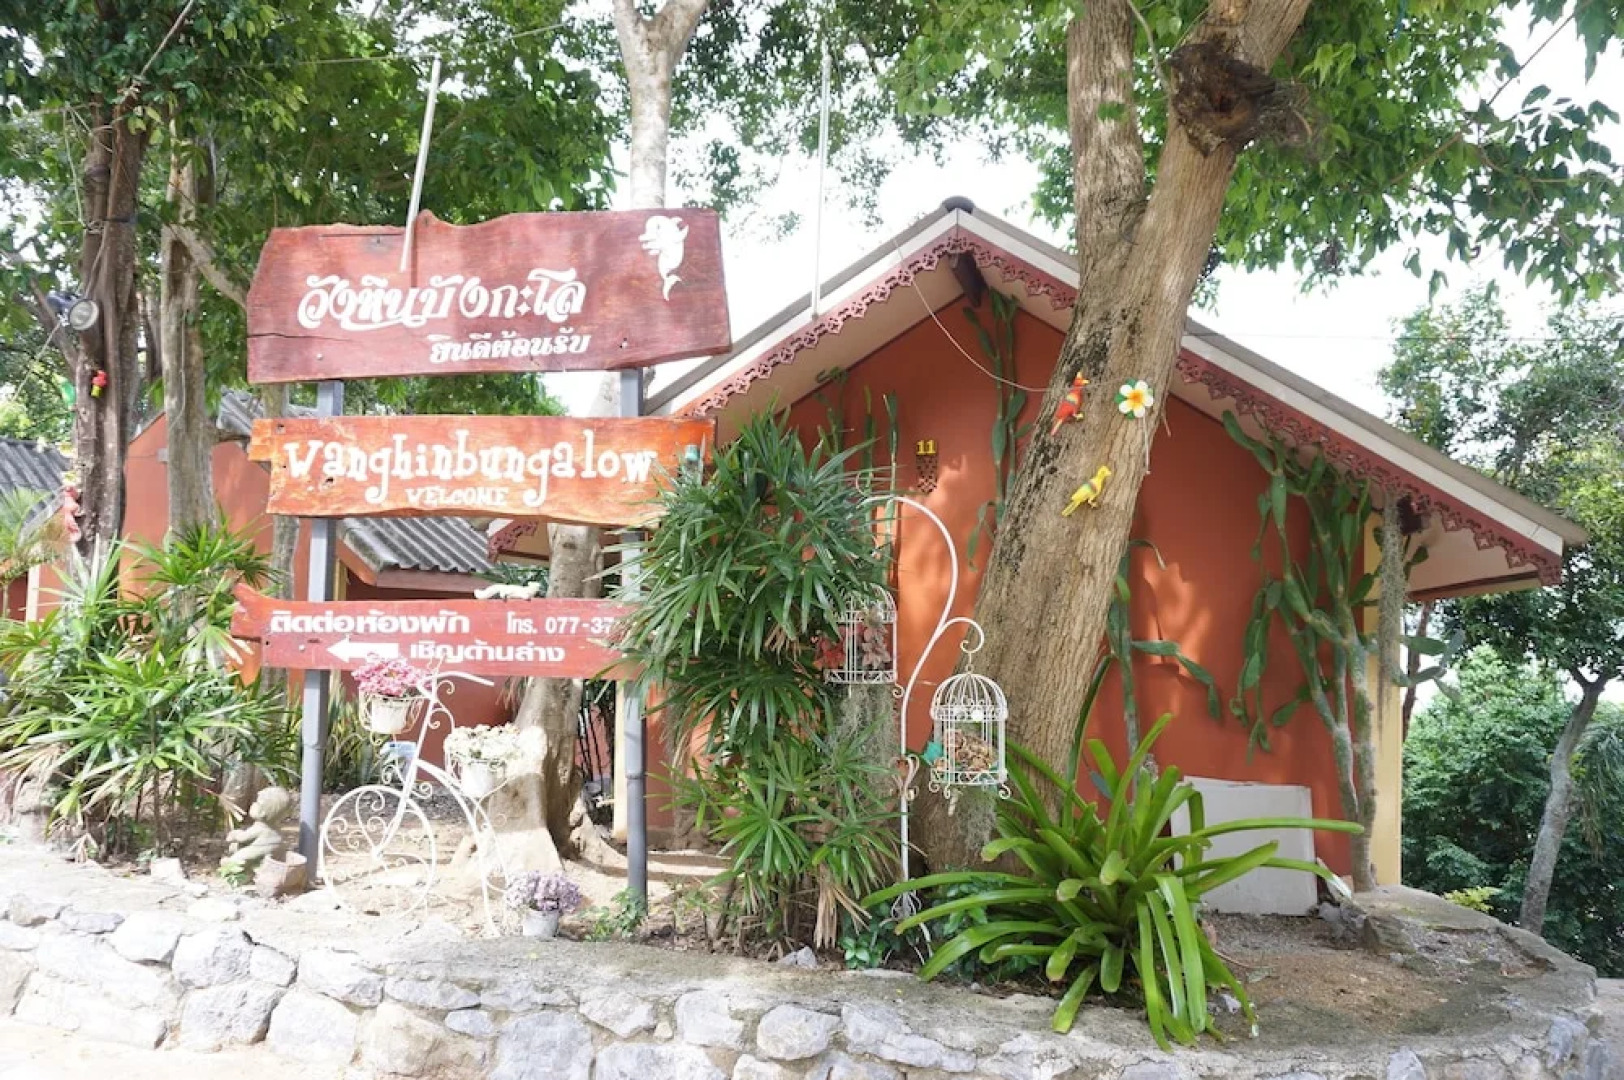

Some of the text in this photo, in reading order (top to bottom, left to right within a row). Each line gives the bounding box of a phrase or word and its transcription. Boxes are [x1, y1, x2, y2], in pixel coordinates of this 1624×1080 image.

[297, 267, 587, 332] วังหินบังกะโล
[427, 326, 592, 364] ยินดีต้อนรับ
[916, 439, 937, 455] 11
[270, 609, 615, 635] ติดต่อห้องพัก โทร. 077-37
[410, 638, 566, 664] เชิญด้านล่าง
